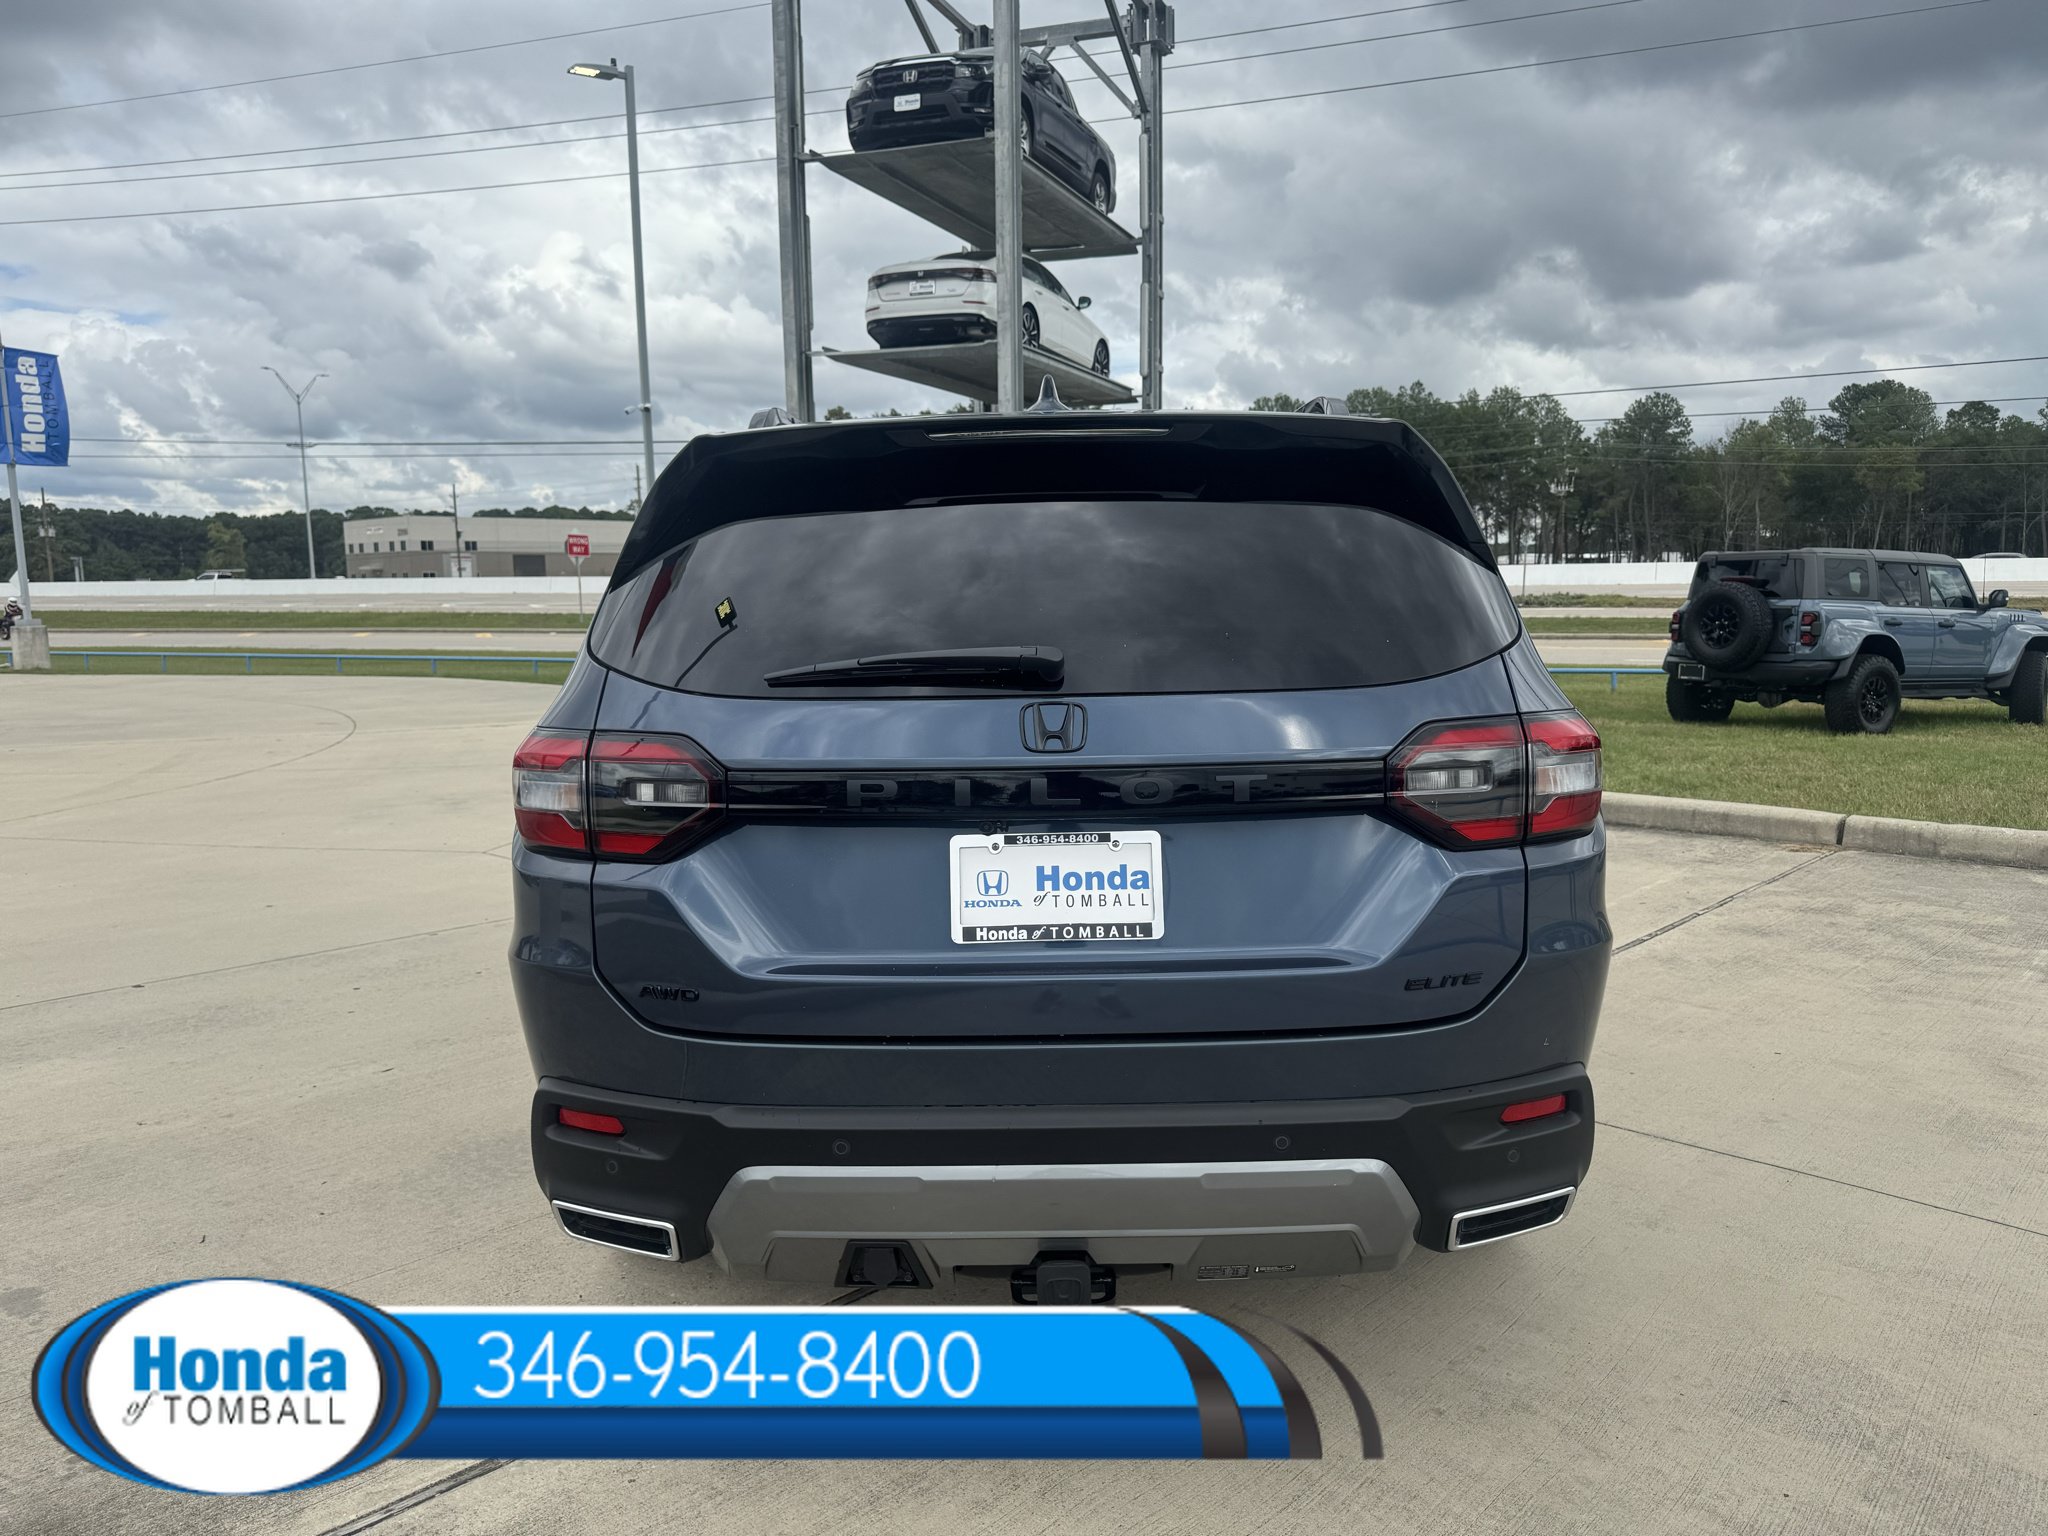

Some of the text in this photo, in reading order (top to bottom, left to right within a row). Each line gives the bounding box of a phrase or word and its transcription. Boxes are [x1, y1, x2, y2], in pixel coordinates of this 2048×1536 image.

[15, 356, 46, 453] Honda
[39, 360, 60, 441] TOMBALL
[569, 537, 589, 545] WRONG
[846, 773, 1268, 807] PILOT
[1016, 834, 1099, 845] 346-954-8400
[1036, 864, 1150, 892] Honda
[964, 899, 1023, 909] HONDA
[1033, 892, 1150, 908] of TOMBALL
[976, 925, 1145, 941] Honda of TOMBALL
[1404, 971, 1485, 992] ELITE
[639, 985, 700, 1002] AWD
